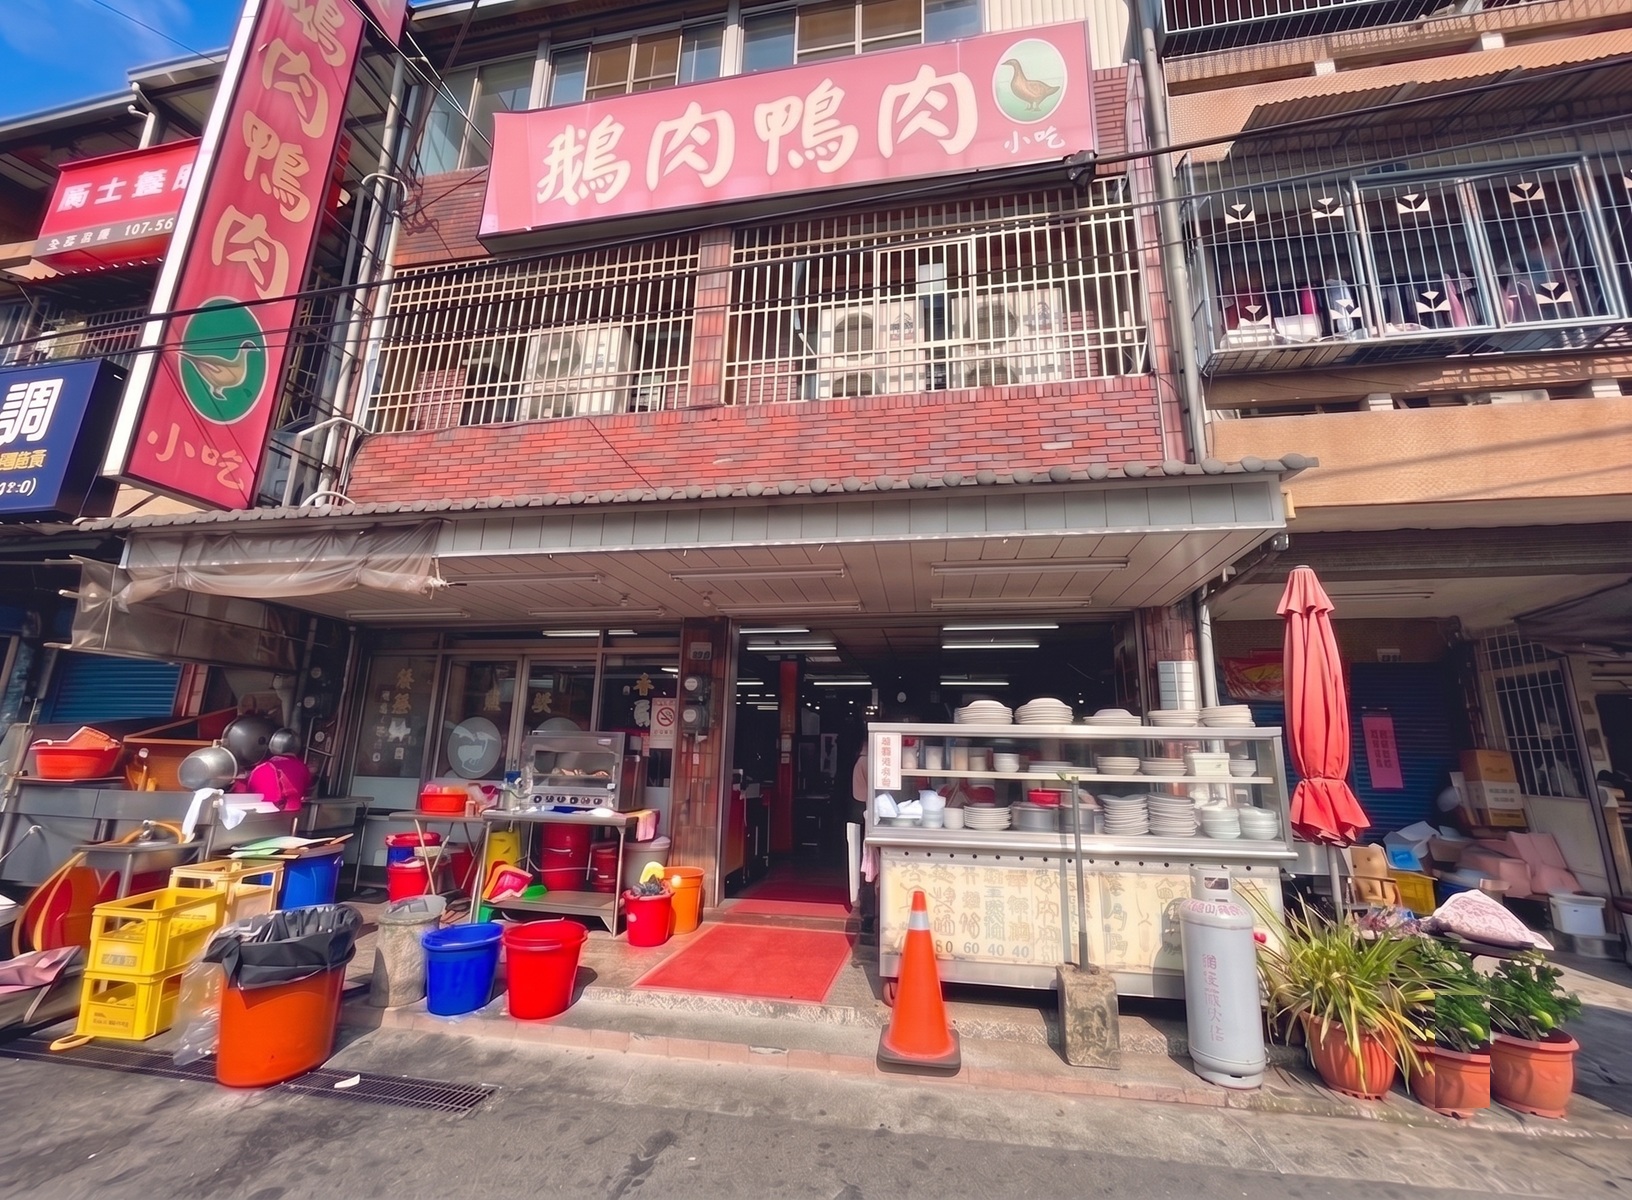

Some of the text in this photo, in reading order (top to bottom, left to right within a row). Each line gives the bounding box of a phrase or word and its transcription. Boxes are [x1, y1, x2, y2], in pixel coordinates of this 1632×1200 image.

[536, 63, 979, 207] 鵝肉鴨肉
[1003, 125, 1067, 155] 小吃
[147, 422, 245, 492] 小吃
